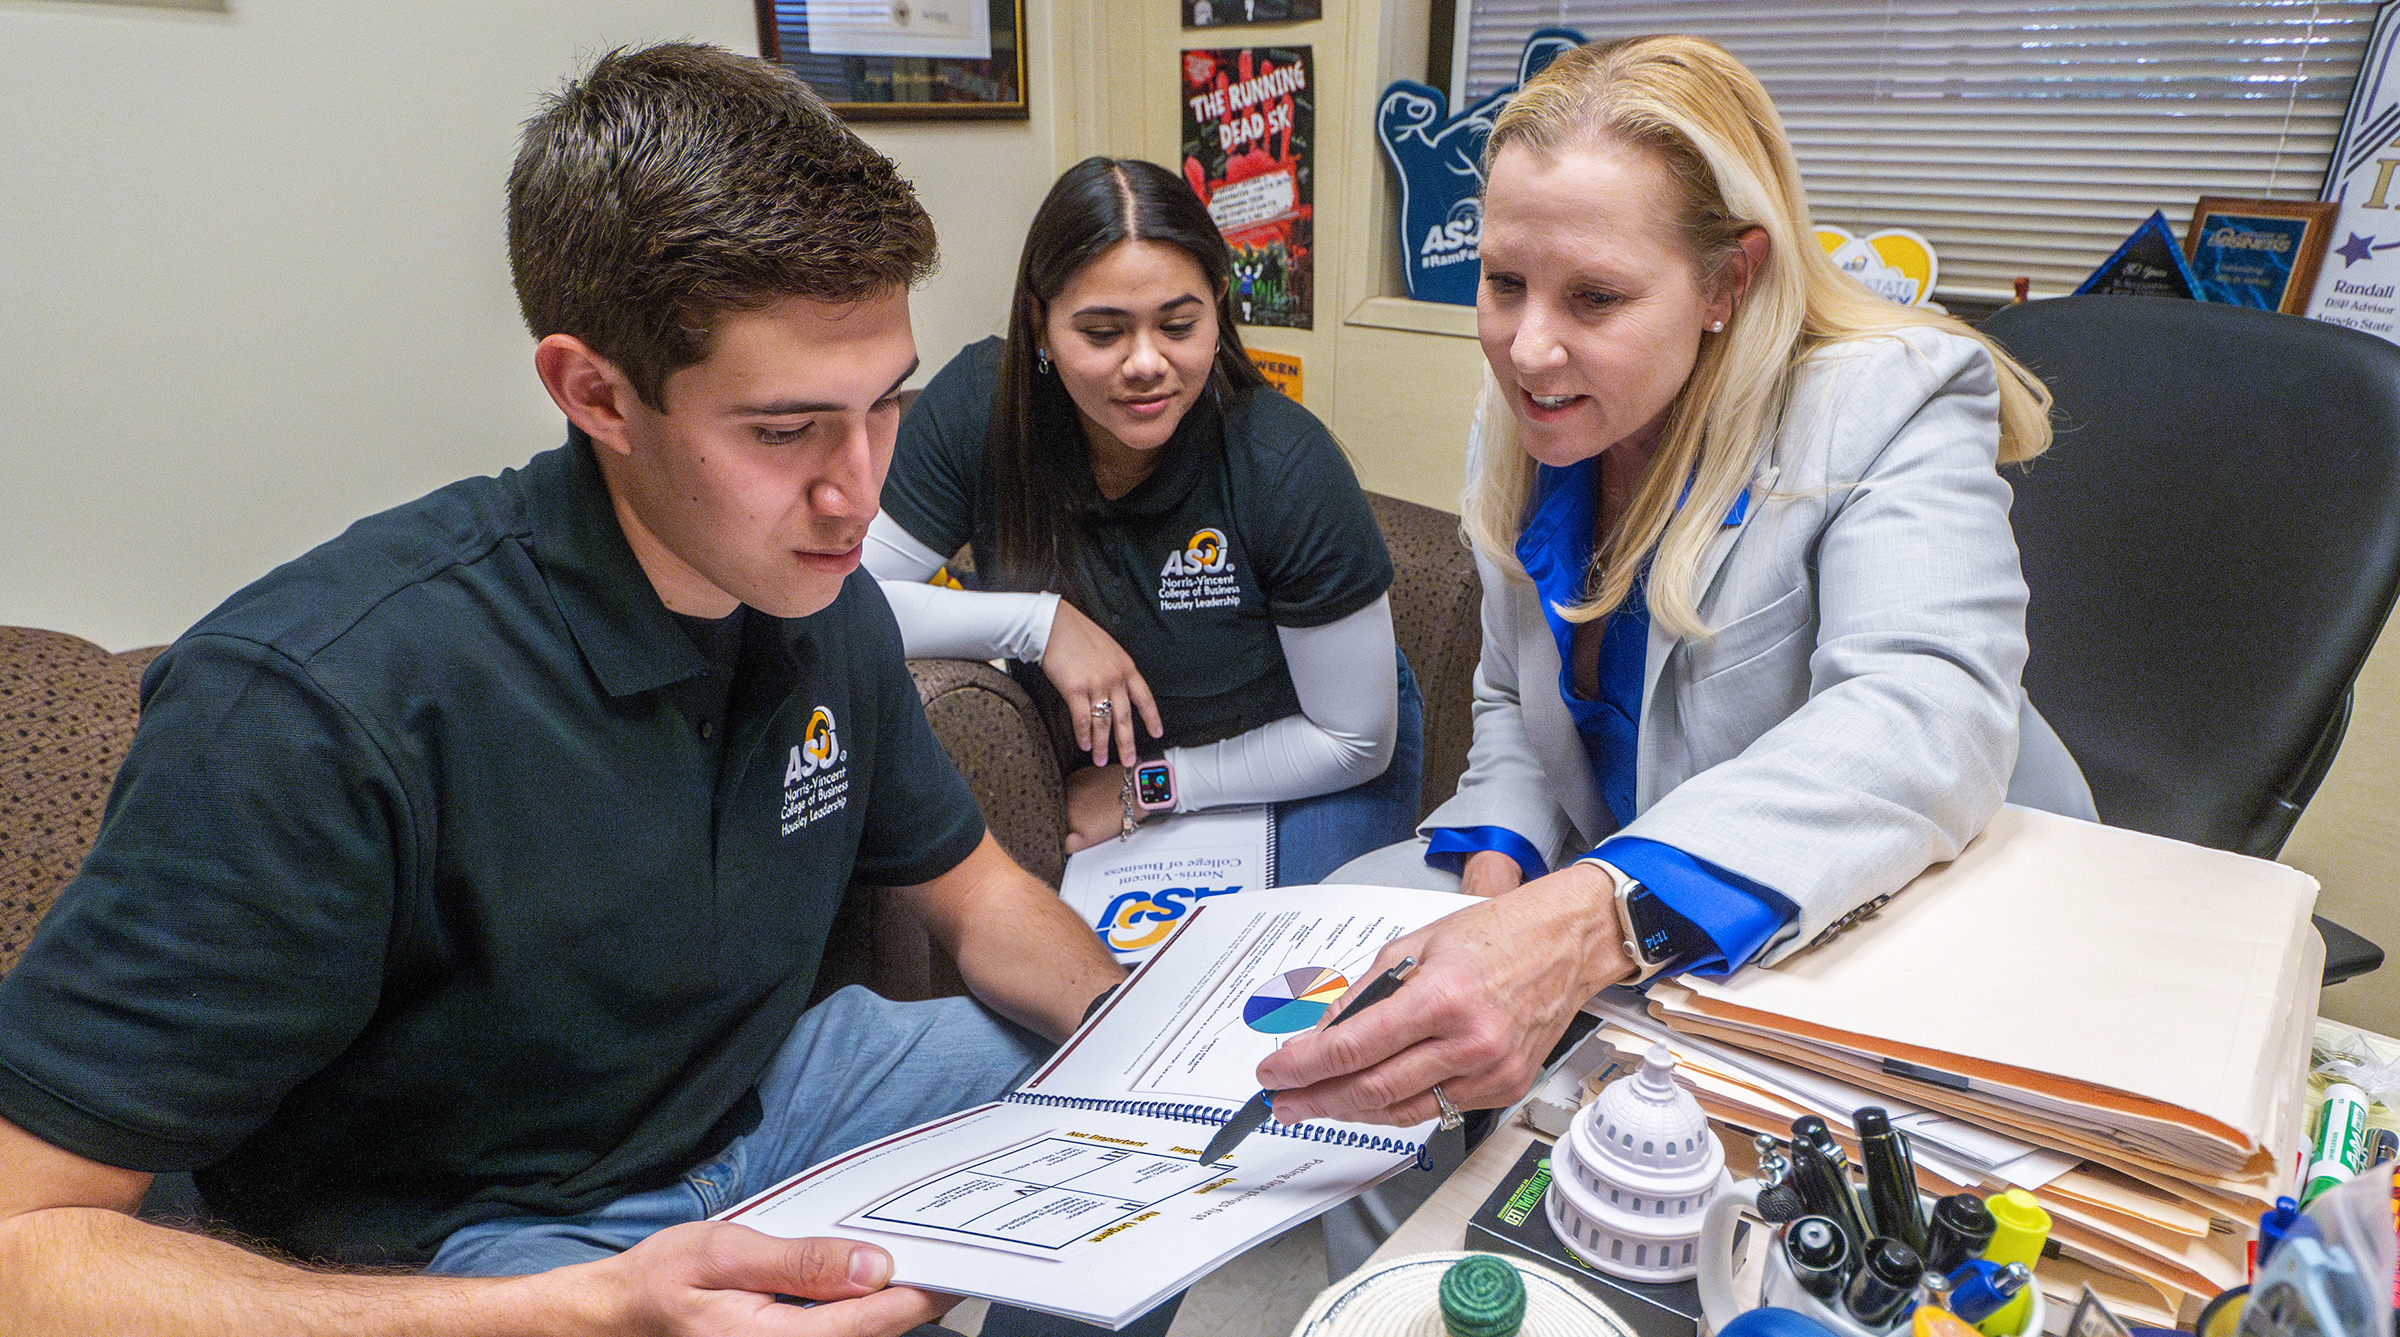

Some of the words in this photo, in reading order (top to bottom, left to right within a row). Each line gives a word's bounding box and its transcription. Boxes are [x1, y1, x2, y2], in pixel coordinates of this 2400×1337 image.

[1190, 90, 1226, 123] THE
[1228, 59, 1305, 111] RUNNING
[1219, 112, 1264, 149] DEAD
[1267, 103, 1291, 135] 5K
[2334, 280, 2396, 298] Randall
[2351, 301, 2395, 315] Advisor
[2360, 319, 2394, 333] State
[1160, 528, 1228, 576] ASU
[1161, 574, 1235, 588] Norris-Vincent
[1158, 588, 1190, 599] College
[1192, 585, 1202, 597] of
[1203, 585, 1240, 596] Business
[1160, 600, 1194, 611] Housley
[1195, 595, 1240, 608] Leadership
[783, 705, 839, 788] ASU
[785, 766, 847, 805] Norris-Vincent
[781, 800, 806, 820] College
[807, 790, 816, 806] of
[817, 780, 849, 801] Business
[781, 814, 808, 837] Housley
[809, 794, 848, 822] Leadership
[1103, 861, 1163, 877] Business
[1166, 859, 1184, 872] of
[1187, 857, 1242, 869] College
[1119, 870, 1224, 885] Norris-Vincent
[1645, 929, 1668, 949] 11:14
[1088, 1134, 1148, 1147] Important
[1097, 1151, 1129, 1161] III
[1277, 1159, 1324, 1180] Putting
[1014, 1185, 1045, 1197] IV
[1194, 1178, 1237, 1194] Urgent
[1254, 1180, 1285, 1191] first
[1514, 1172, 1552, 1211] PRINCIPAL
[1218, 1190, 1264, 1208] things
[1132, 1211, 1161, 1222] Not
[1191, 1208, 1223, 1220] first
[1504, 1208, 1525, 1226] LED
[1088, 1222, 1138, 1243] Urgent
